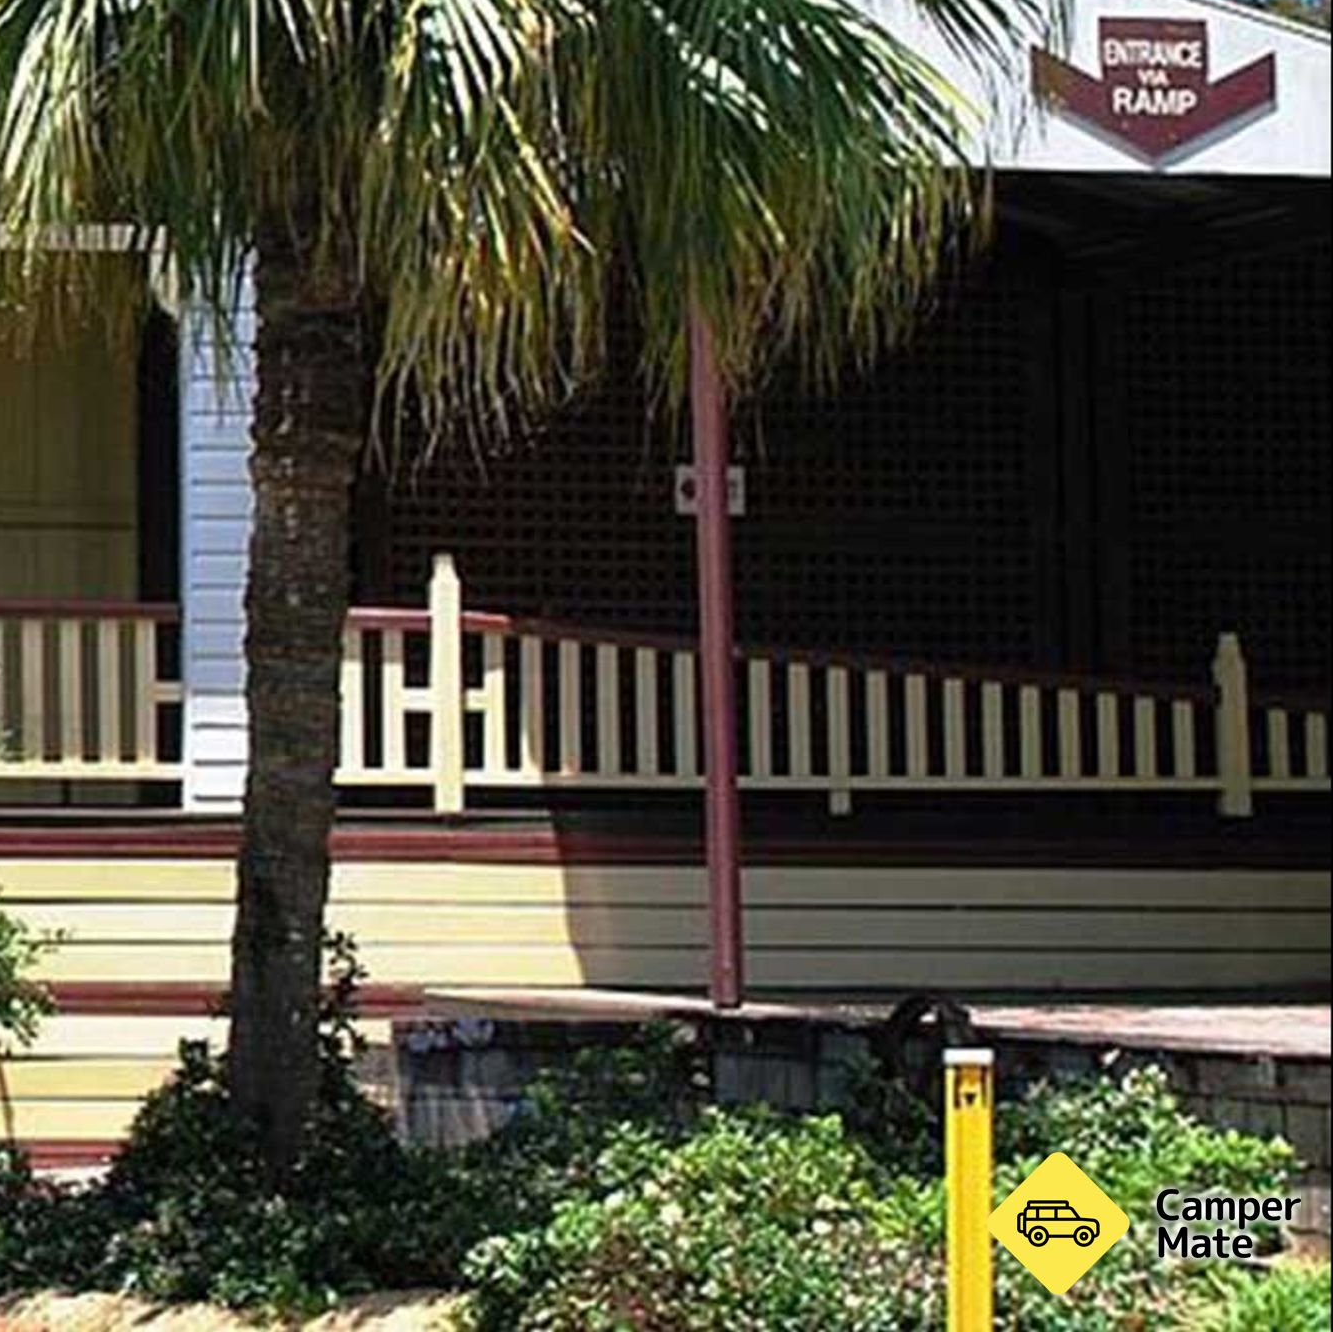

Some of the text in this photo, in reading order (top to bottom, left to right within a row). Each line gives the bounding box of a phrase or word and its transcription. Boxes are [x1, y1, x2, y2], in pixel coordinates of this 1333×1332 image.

[1102, 37, 1202, 68] ENTRANCE
[1136, 68, 1170, 86] VIA
[1111, 87, 1197, 115] RAMP
